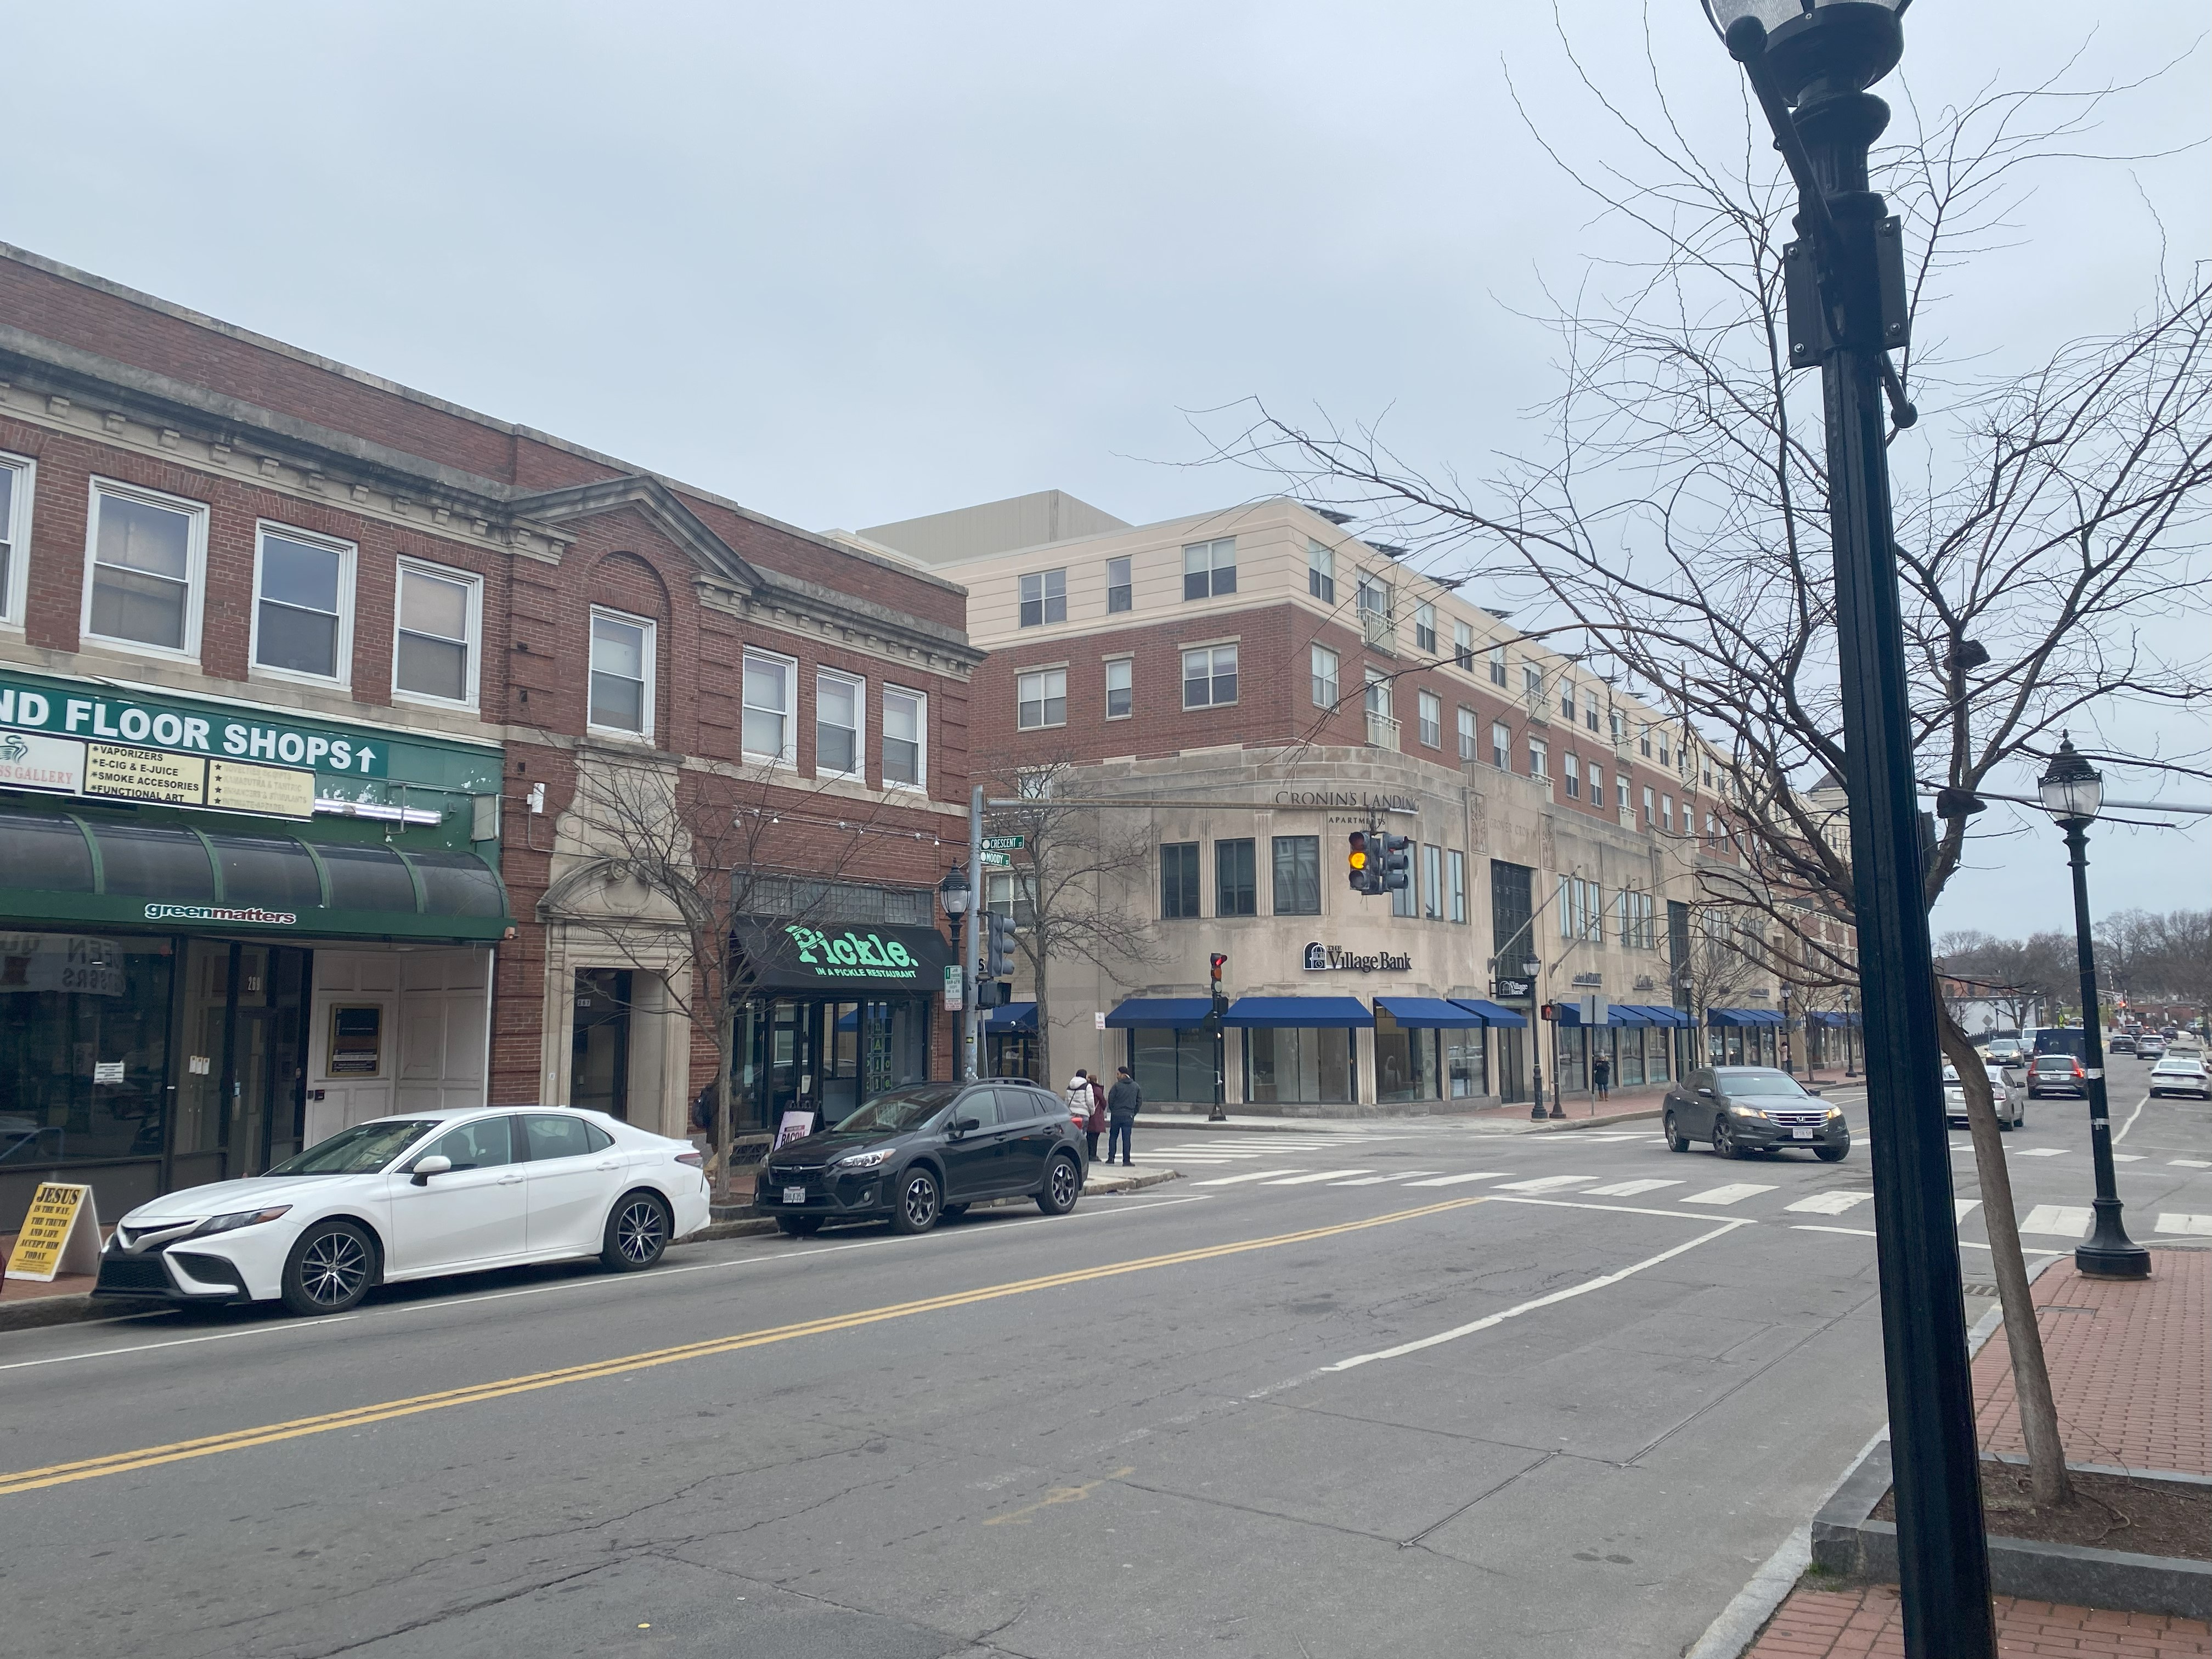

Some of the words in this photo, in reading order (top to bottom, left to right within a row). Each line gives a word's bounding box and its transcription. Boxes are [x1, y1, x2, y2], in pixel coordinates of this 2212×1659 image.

[65, 699, 210, 750] FLOOR
[223, 724, 351, 769] SHOPS
[100, 746, 163, 761] VAPORIZERS
[15, 767, 73, 785] GALLERY
[99, 759, 126, 770] E-CIG
[140, 764, 178, 776] E-JUICE
[98, 772, 134, 783] SMOKE
[137, 777, 199, 791] ACCESORIES
[97, 785, 162, 800] FUNCTIONAL
[165, 793, 184, 803] ART
[1276, 791, 1357, 806] CRONIN'S
[1363, 792, 1420, 811] LANDING
[1329, 817, 1385, 825] APARTMETS
[991, 838, 1016, 849] CRESCENT
[986, 853, 1003, 864] MOODY
[145, 904, 296, 924] greenmatters
[785, 925, 919, 967] Pickle.
[1327, 951, 1378, 973] Village
[1379, 951, 1412, 969] Bank
[815, 967, 826, 976] IN
[836, 968, 866, 977] PICKLE
[866, 969, 917, 978] RESTAURANT
[37, 1188, 80, 1205] JESUS
[45, 1218, 67, 1227] TRUTH
[43, 1229, 59, 1238] LIFE
[20, 1239, 46, 1248] ACCEPT
[46, 1241, 59, 1250] HIM
[24, 1251, 47, 1260] TODAY
